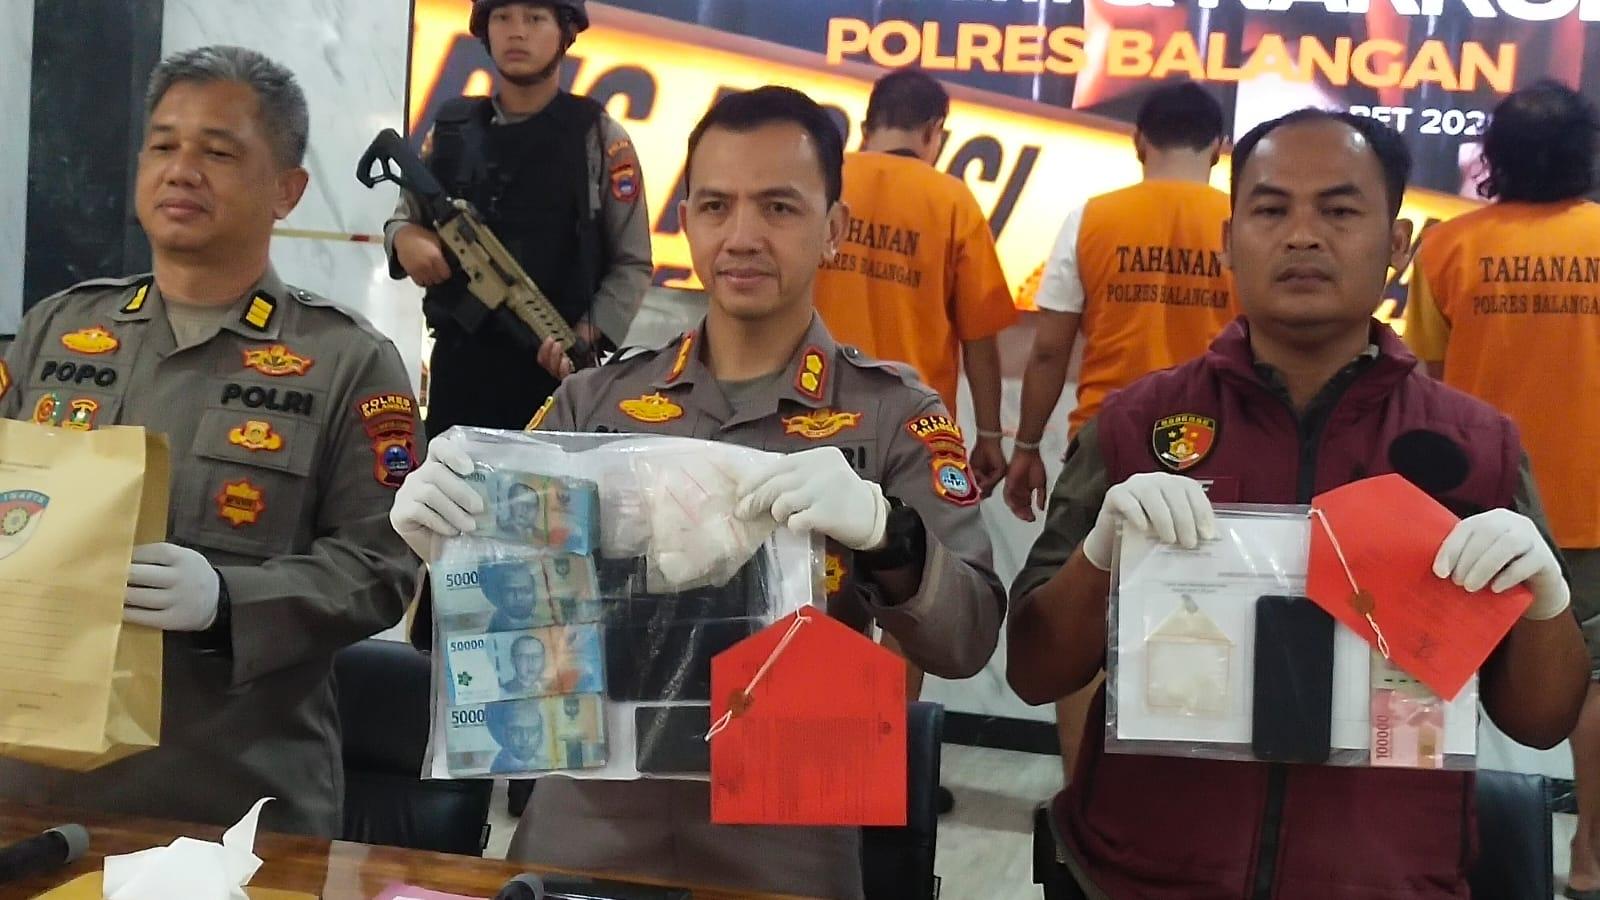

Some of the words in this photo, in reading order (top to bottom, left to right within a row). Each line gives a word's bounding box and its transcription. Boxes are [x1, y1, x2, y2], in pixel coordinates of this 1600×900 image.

[827, 17, 1088, 76] POLRES
[1106, 29, 1518, 94] BALANGAN
[1420, 108, 1494, 136] 202
[847, 217, 921, 256] HANAN
[1116, 245, 1221, 278] TAHANAN
[1479, 255, 1600, 283] TAHANAN
[1106, 284, 1158, 303] POLRES
[1160, 285, 1229, 308] BALANGAN
[1473, 294, 1527, 315] POLRES
[40, 360, 117, 388] POPO
[220, 383, 314, 416] POLRI
[450, 639, 484, 653] 50000
